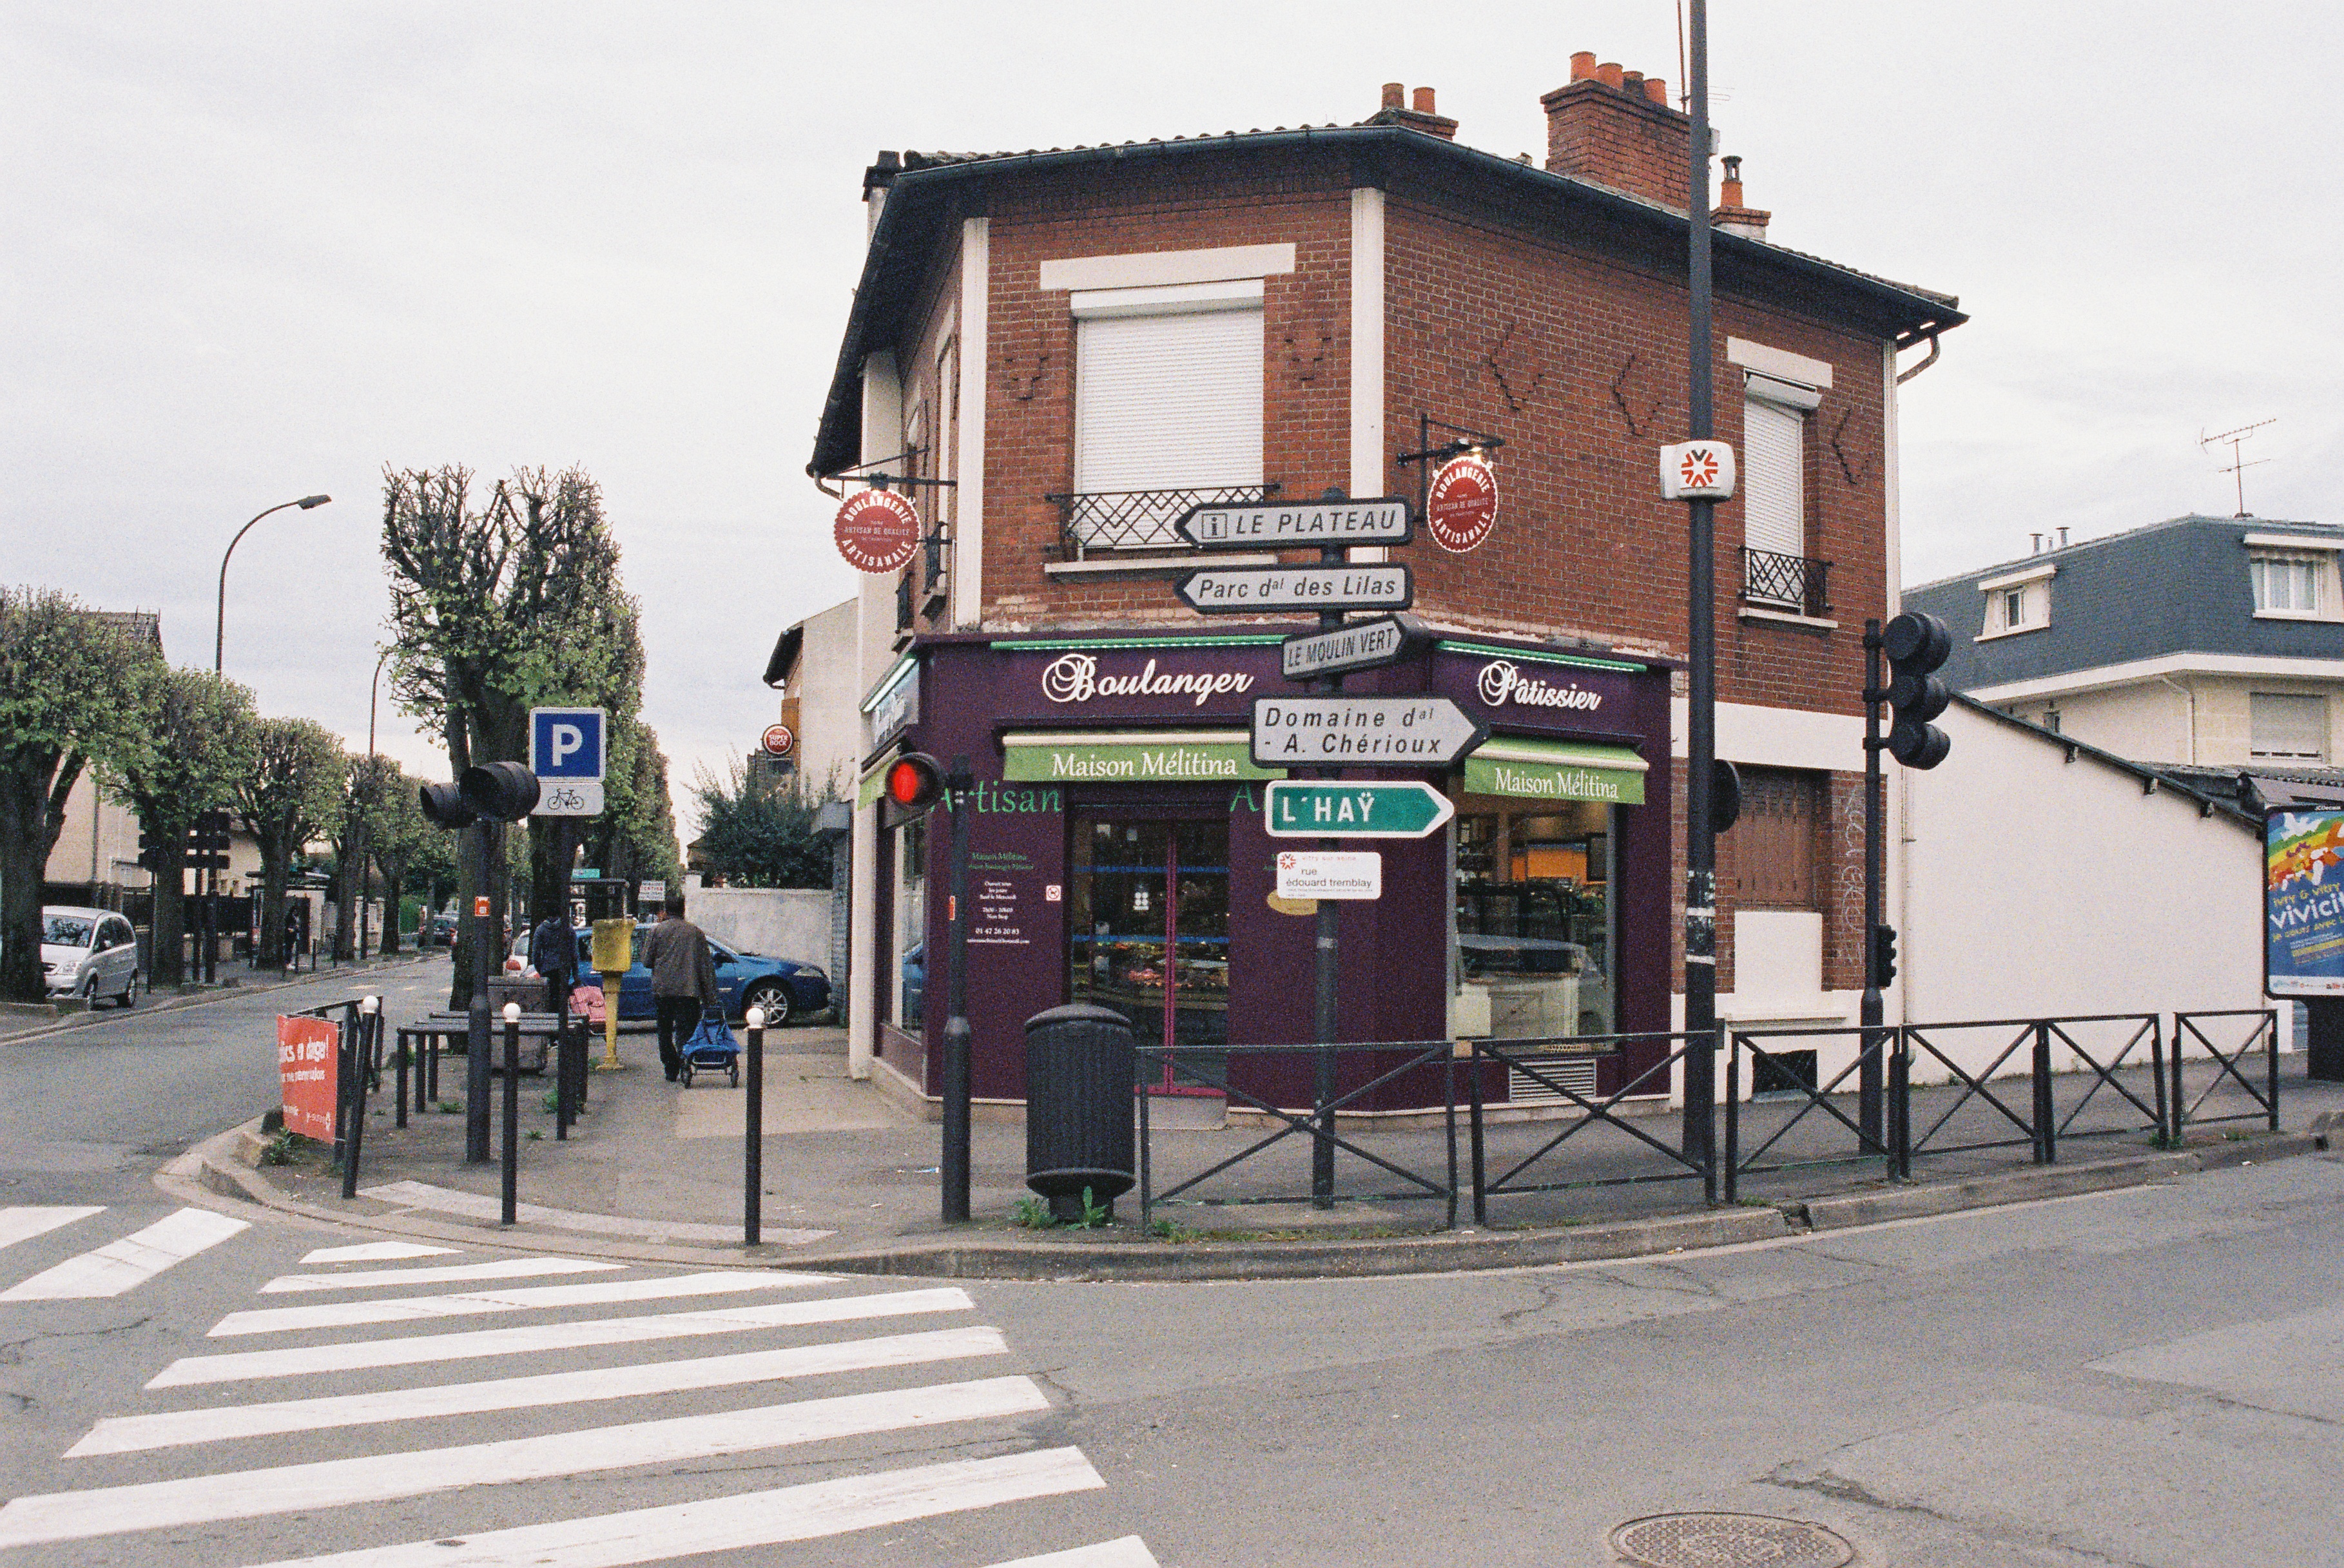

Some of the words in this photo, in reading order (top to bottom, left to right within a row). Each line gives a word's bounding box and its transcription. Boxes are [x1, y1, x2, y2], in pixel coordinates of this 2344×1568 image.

[1437, 466, 1490, 499] BOULANGERIE
[844, 496, 911, 524] BOULANGERIE
[1236, 514, 1263, 535] LE
[1277, 510, 1397, 534] PLATEAU
[1435, 511, 1490, 544] ARTISANALE
[842, 538, 911, 567] ARTISANALE
[1198, 579, 1249, 599] Parc
[1293, 577, 1332, 596] des
[1342, 576, 1397, 595] Lilas
[1288, 646, 1301, 668] LE
[1305, 636, 1355, 664] MOULIN
[1359, 628, 1395, 654] VERT
[1041, 653, 1254, 706] Boulanger
[1478, 660, 1603, 711] Pâtissier
[1264, 707, 1386, 728] Domaine
[552, 724, 583, 766] P
[1283, 733, 1306, 753] A.
[1321, 732, 1441, 754] Chérioux
[1052, 753, 1136, 777] Maison
[1141, 750, 1239, 777] Mélitina
[931, 780, 1062, 813] Atisan
[1495, 768, 1555, 795] Maison
[1557, 770, 1619, 799] Mélitina
[1282, 791, 1376, 822] L'HAŸ
[1286, 878, 1326, 887] édouard
[1330, 878, 1372, 888] tremblay
